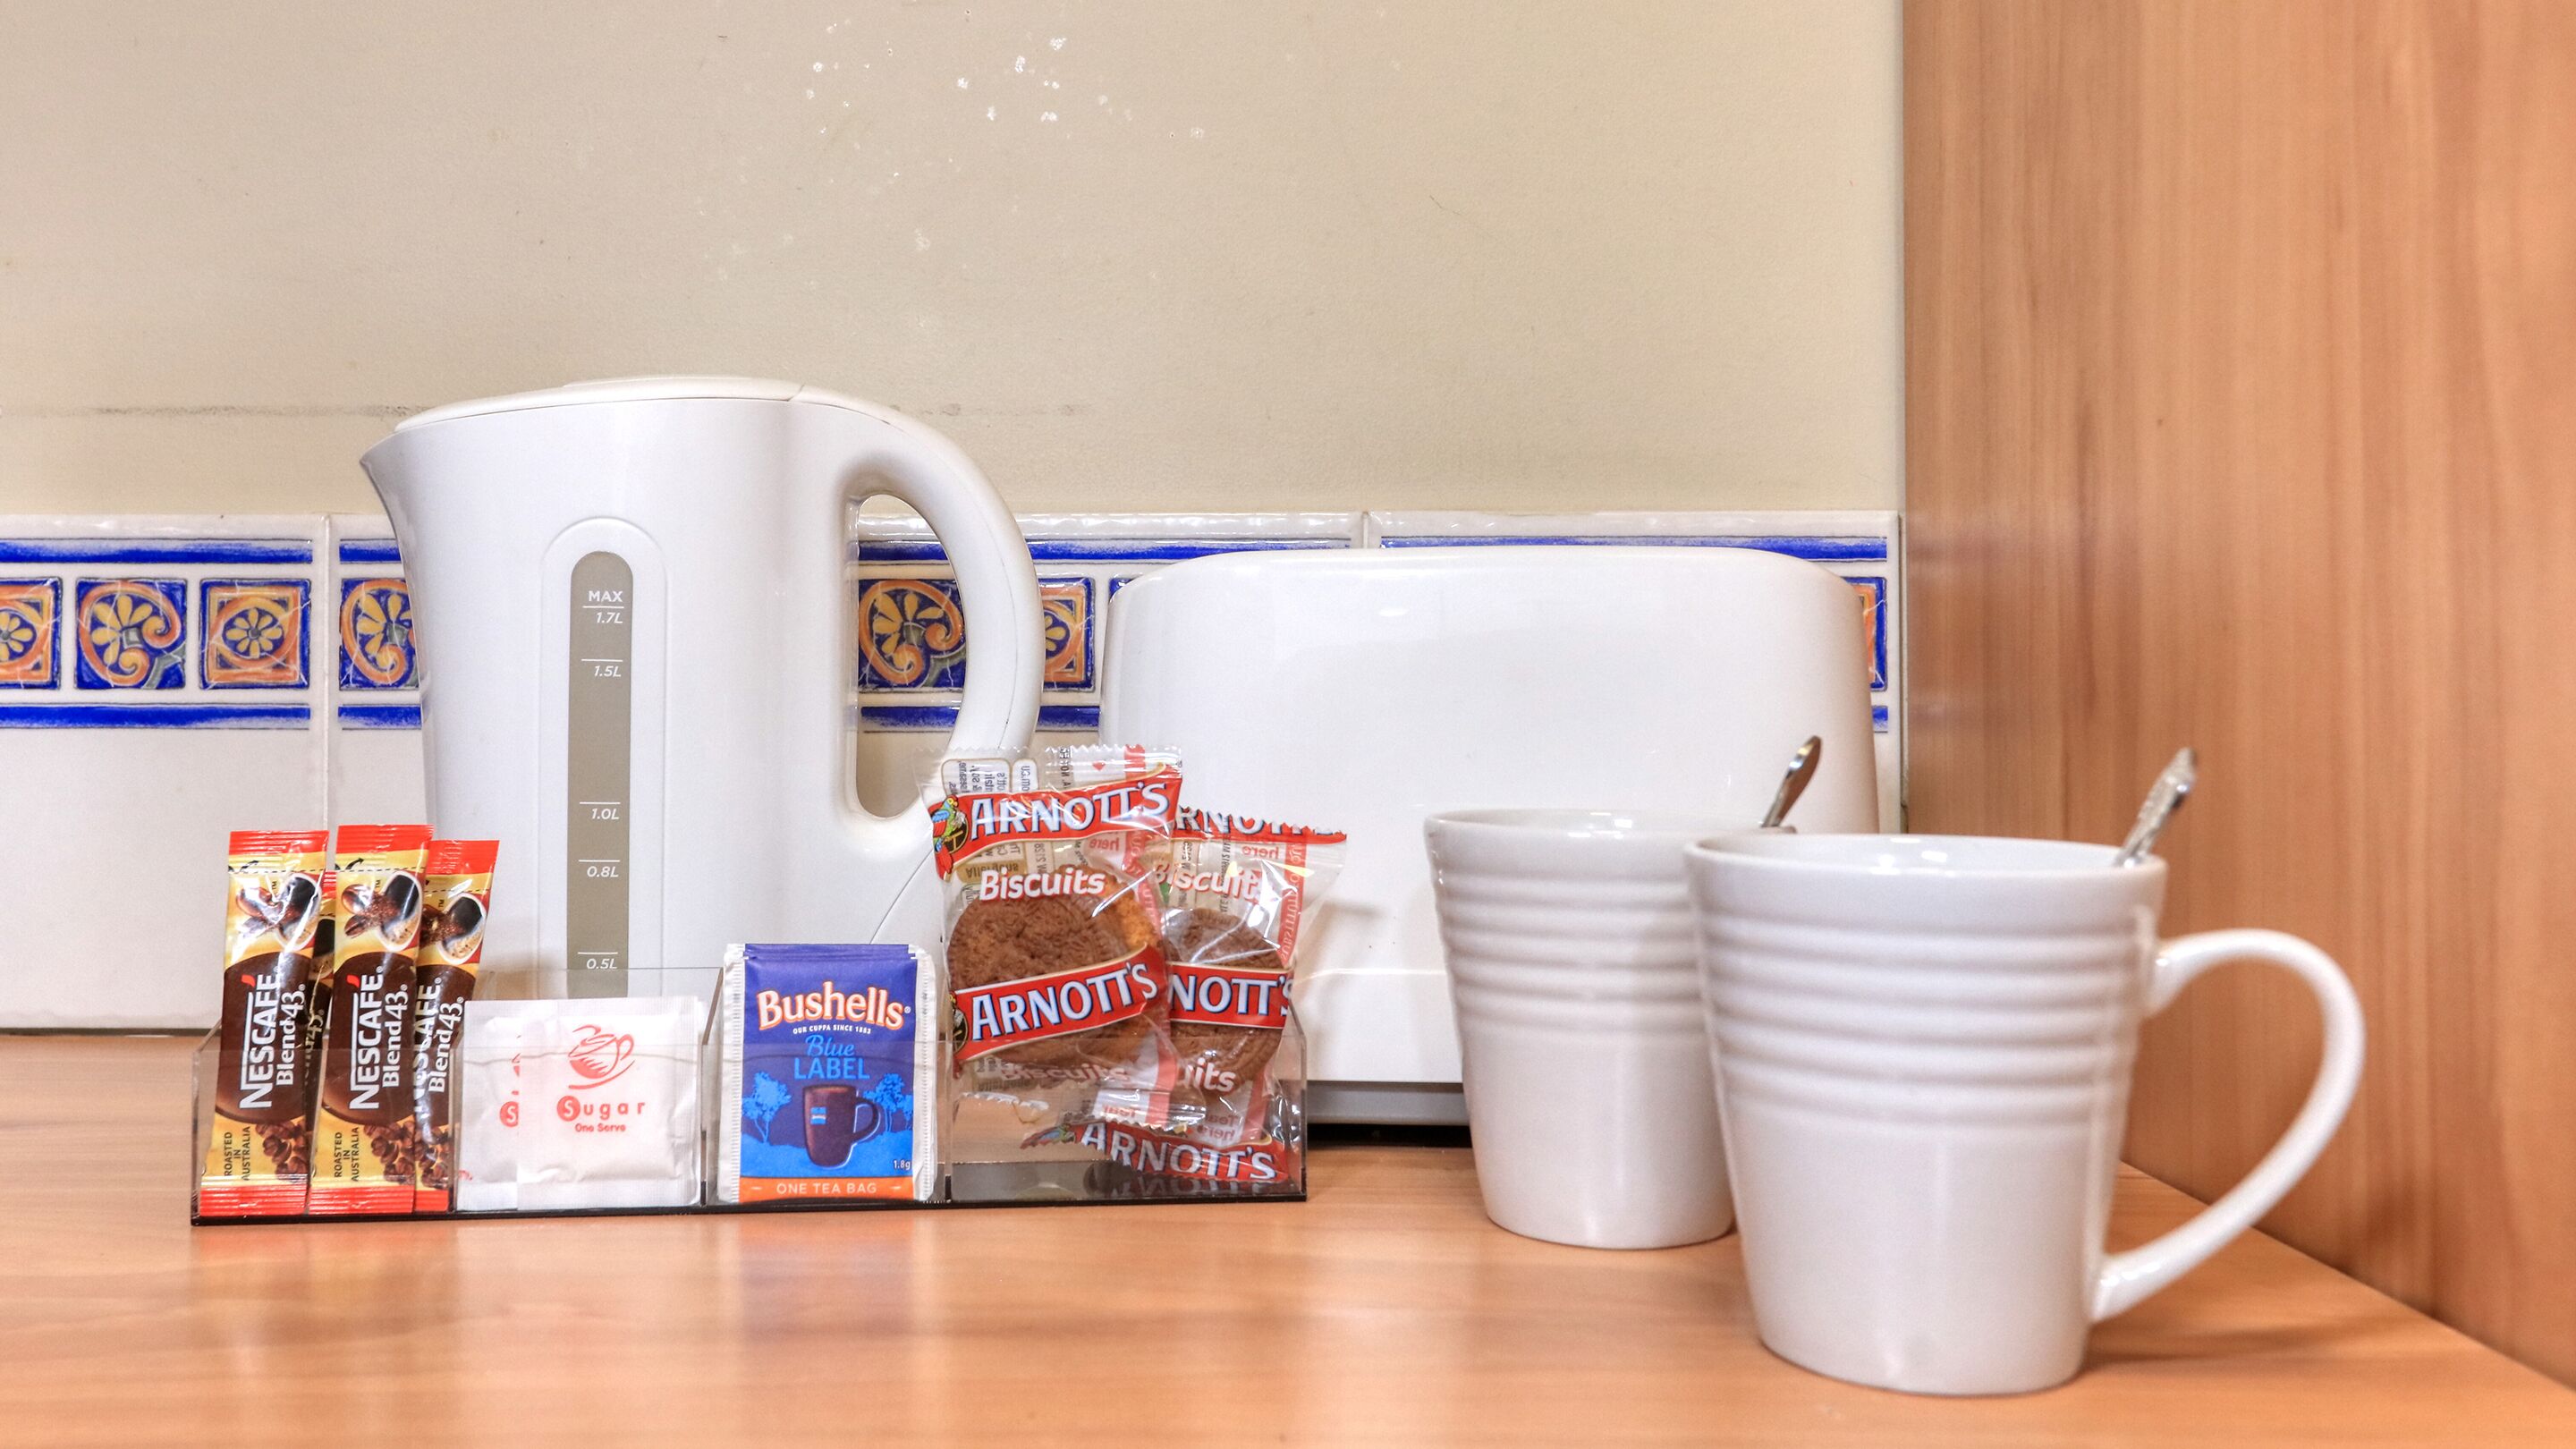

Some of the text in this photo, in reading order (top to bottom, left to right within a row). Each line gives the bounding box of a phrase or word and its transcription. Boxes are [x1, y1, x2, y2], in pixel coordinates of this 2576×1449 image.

[588, 590, 623, 603] MAX
[596, 611, 623, 624] 1.7L
[594, 665, 622, 678] 1.5L
[591, 808, 620, 820] 1.0L
[970, 781, 1170, 842] ARNOTT'S
[587, 866, 619, 878] 0.8L
[978, 867, 1107, 902] Biscuits
[587, 957, 618, 970] 0.5L
[756, 981, 906, 1030] Bushells
[970, 961, 1159, 1042] ARNOTT'S
[792, 1026, 807, 1035] OUR
[809, 1024, 831, 1032] CUPPA
[805, 1034, 855, 1057] Blue
[793, 1058, 870, 1080] LABEL
[560, 1097, 646, 1121] Sugar
[575, 1123, 626, 1132] One Serve
[225, 1131, 233, 1177] ROASTED
[234, 1149, 242, 1159] IN
[242, 1126, 251, 1182] AUSTRALIA
[334, 1131, 342, 1178] ROASTED
[343, 1149, 351, 1160] IN
[351, 1127, 359, 1182] AUSTRALIA
[1080, 1123, 1277, 1180] ARNOTT'S
[894, 1159, 911, 1171] 1.8g
[776, 1182, 877, 1194] ONE TEA BAG
